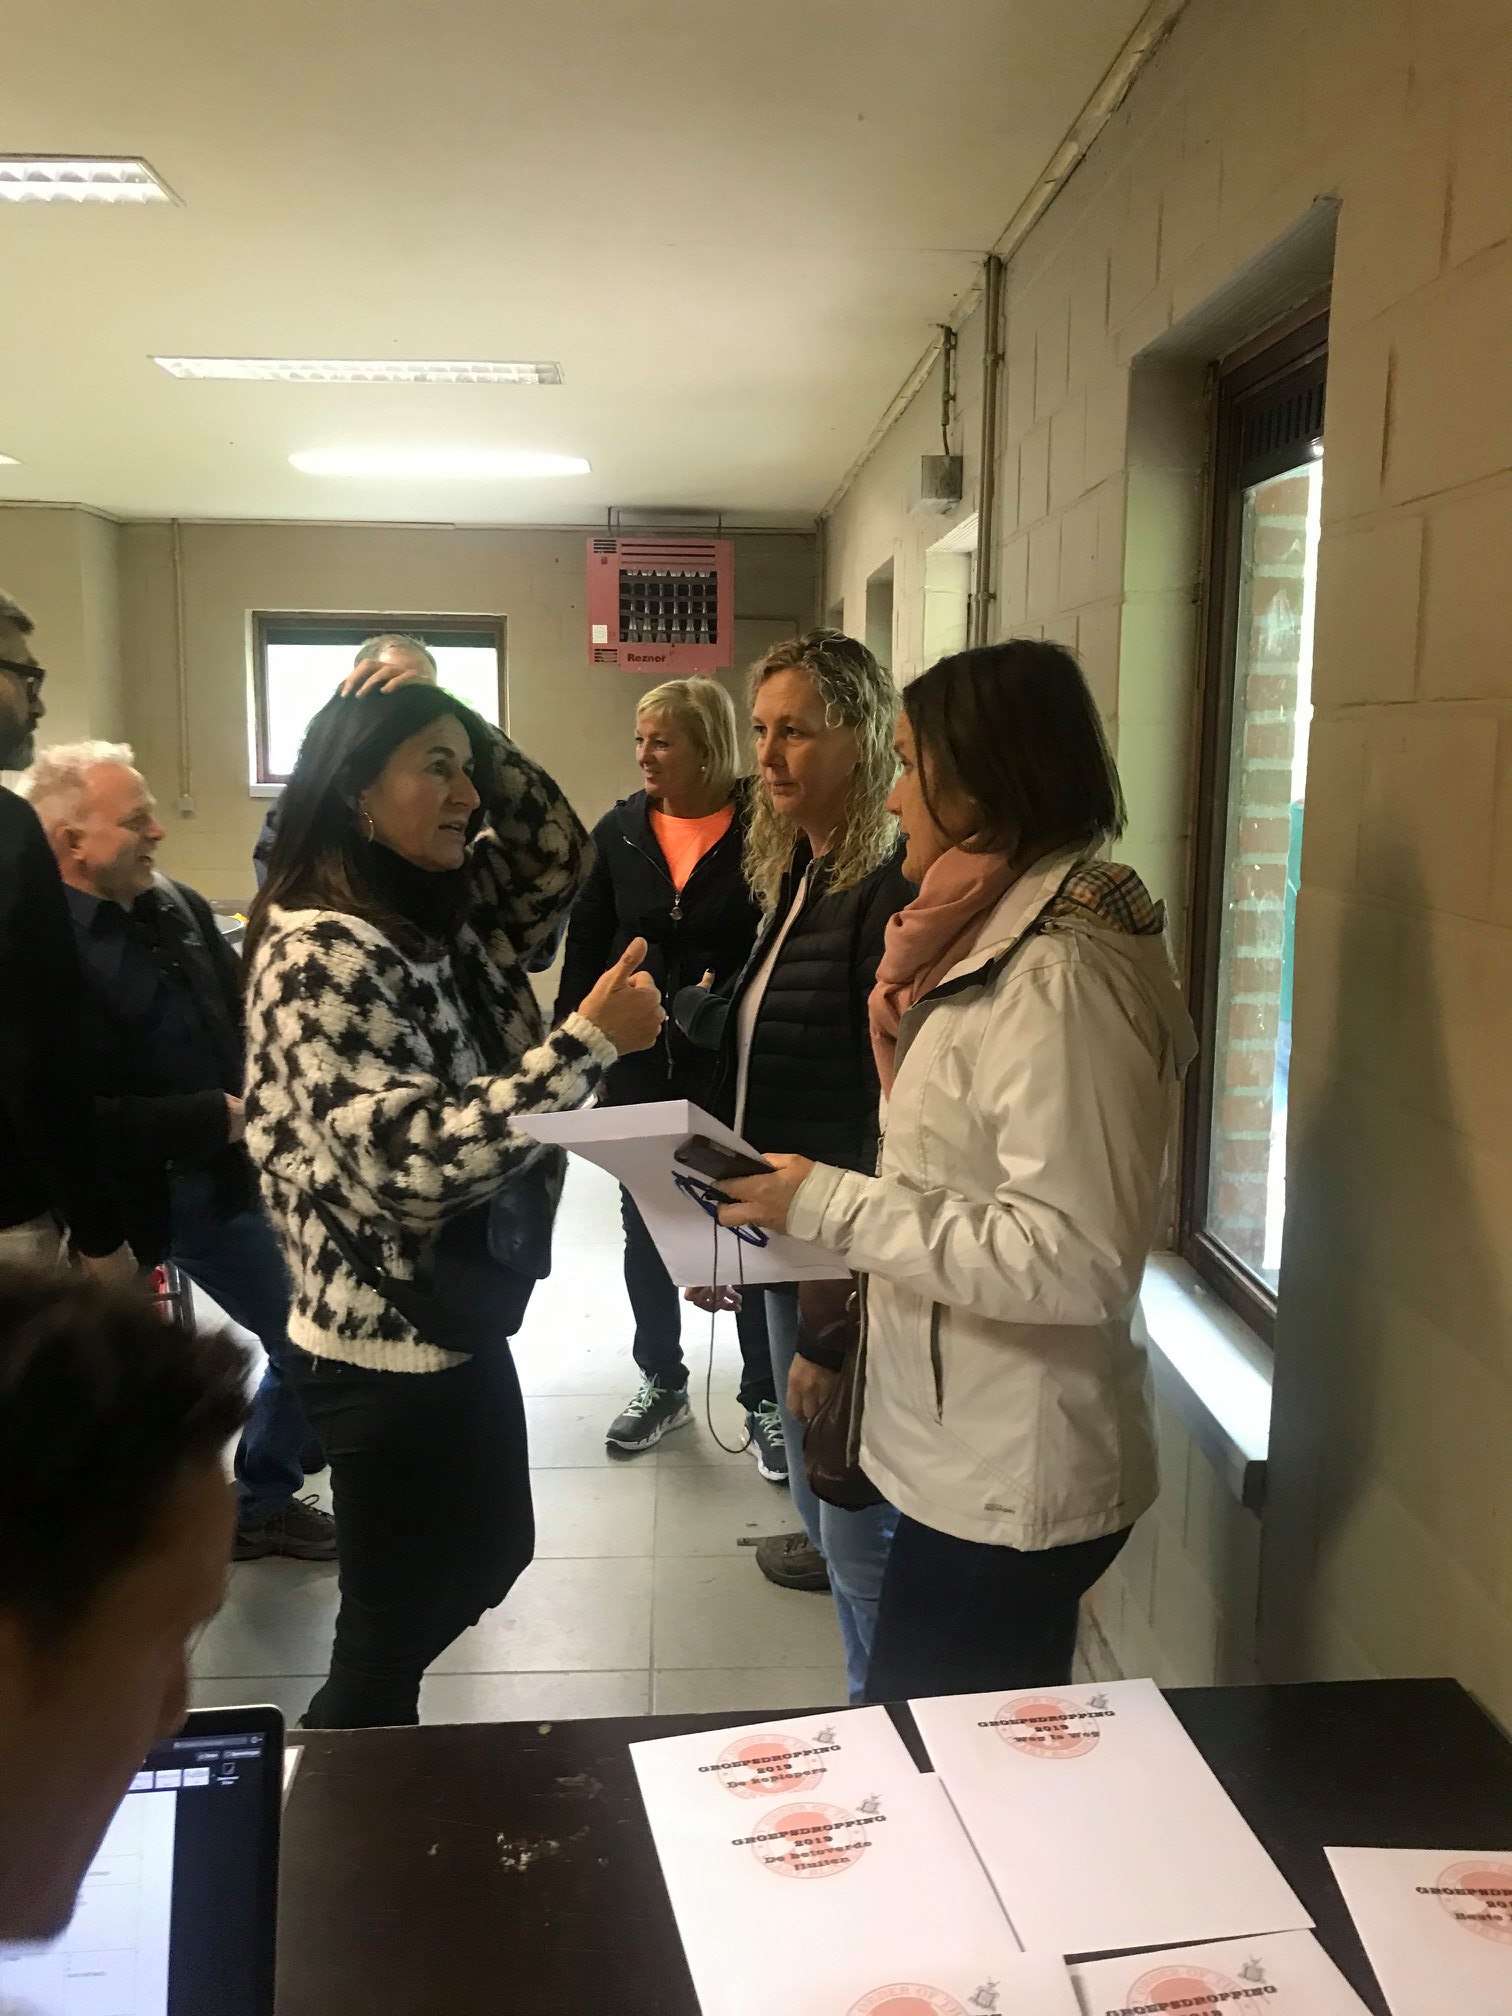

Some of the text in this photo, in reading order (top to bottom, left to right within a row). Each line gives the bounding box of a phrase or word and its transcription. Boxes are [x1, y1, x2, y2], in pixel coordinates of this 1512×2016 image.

[627, 653, 666, 662] Reznor
[978, 1710, 1115, 1727] GROEPSDROPPING
[1034, 1724, 1069, 1732] 2019
[698, 1744, 841, 1773] GROEPSDROPPING
[757, 1763, 792, 1774] 2019
[731, 1815, 887, 1846] GROEPSDROPPING
[794, 1836, 833, 1847] 2019
[764, 1856, 785, 1864] De
